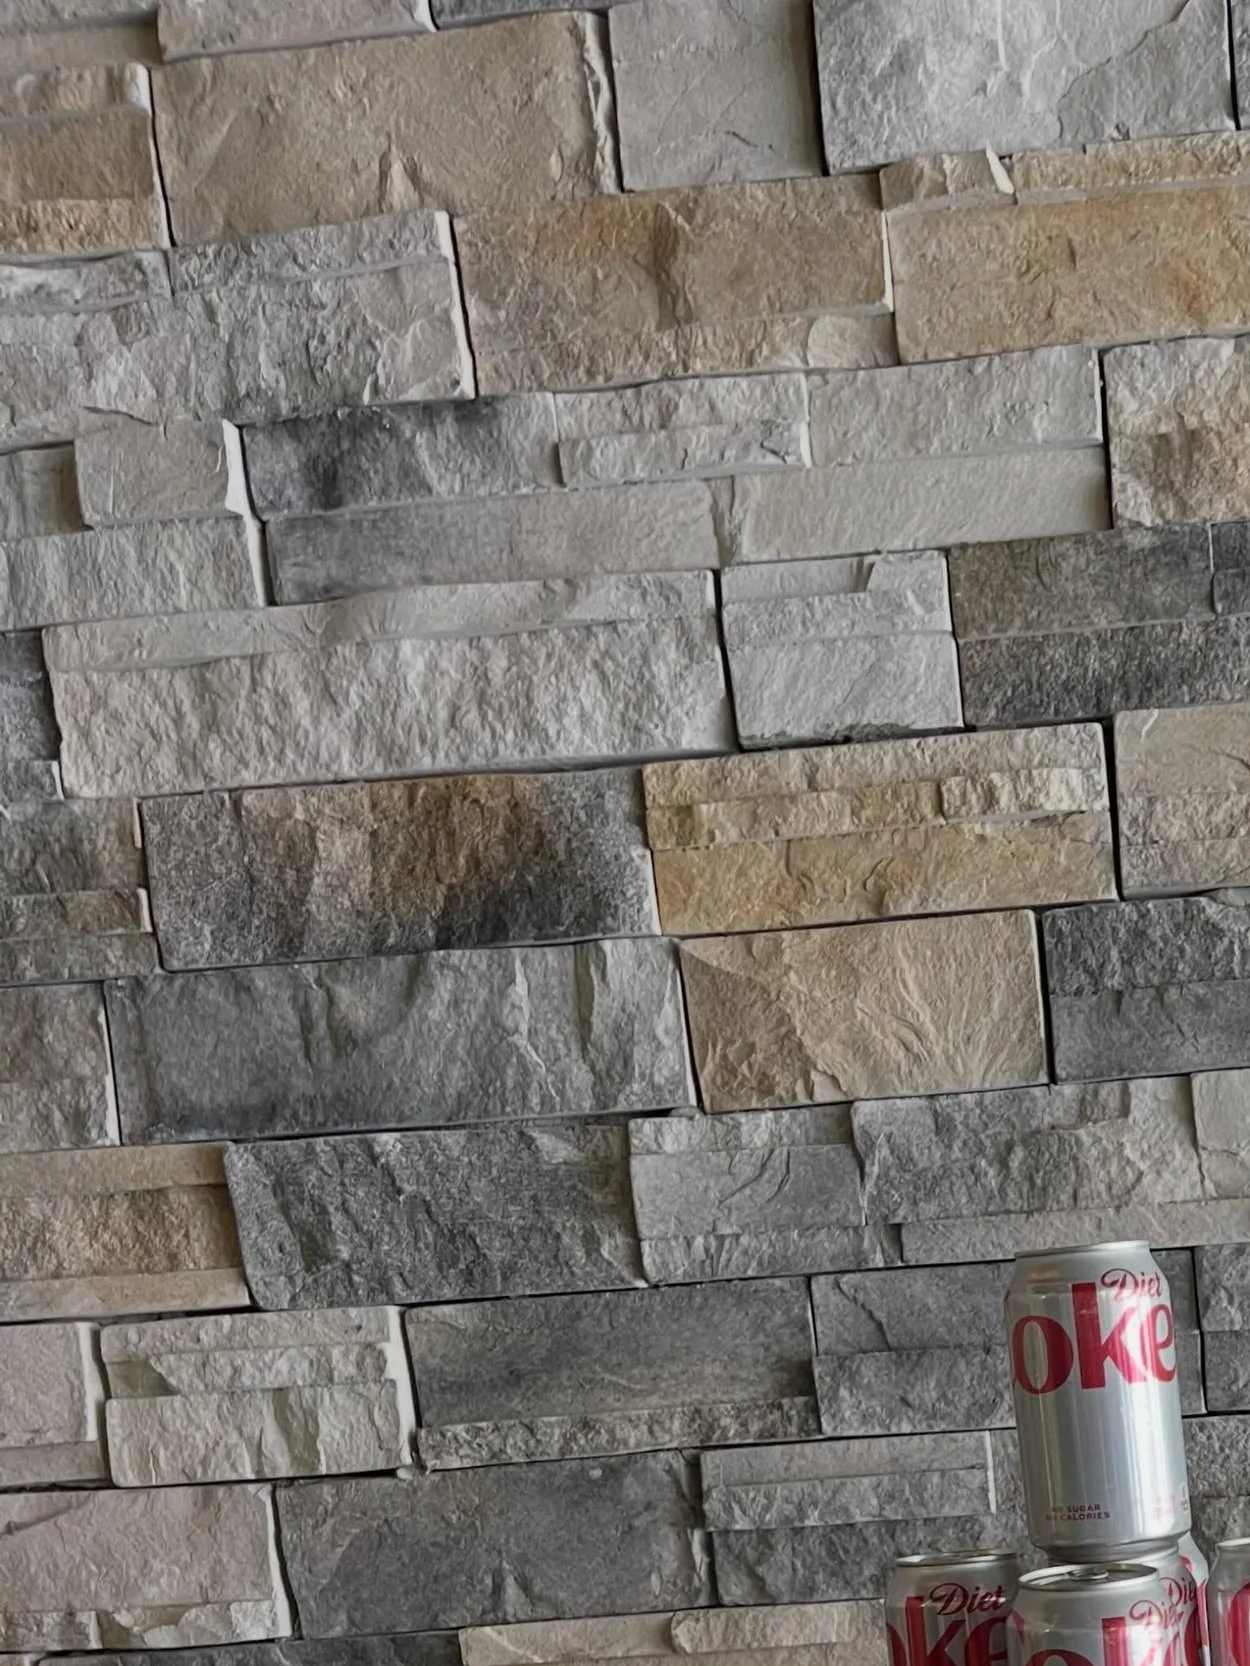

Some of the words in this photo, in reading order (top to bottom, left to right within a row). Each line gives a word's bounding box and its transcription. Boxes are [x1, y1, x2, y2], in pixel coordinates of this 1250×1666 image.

[1101, 1268, 1162, 1302] Diet
[1008, 1282, 1177, 1395] oke
[1060, 1511, 1111, 1522] CALORIES
[1067, 1503, 1101, 1513] SUGAR
[929, 1583, 1006, 1616] Diet
